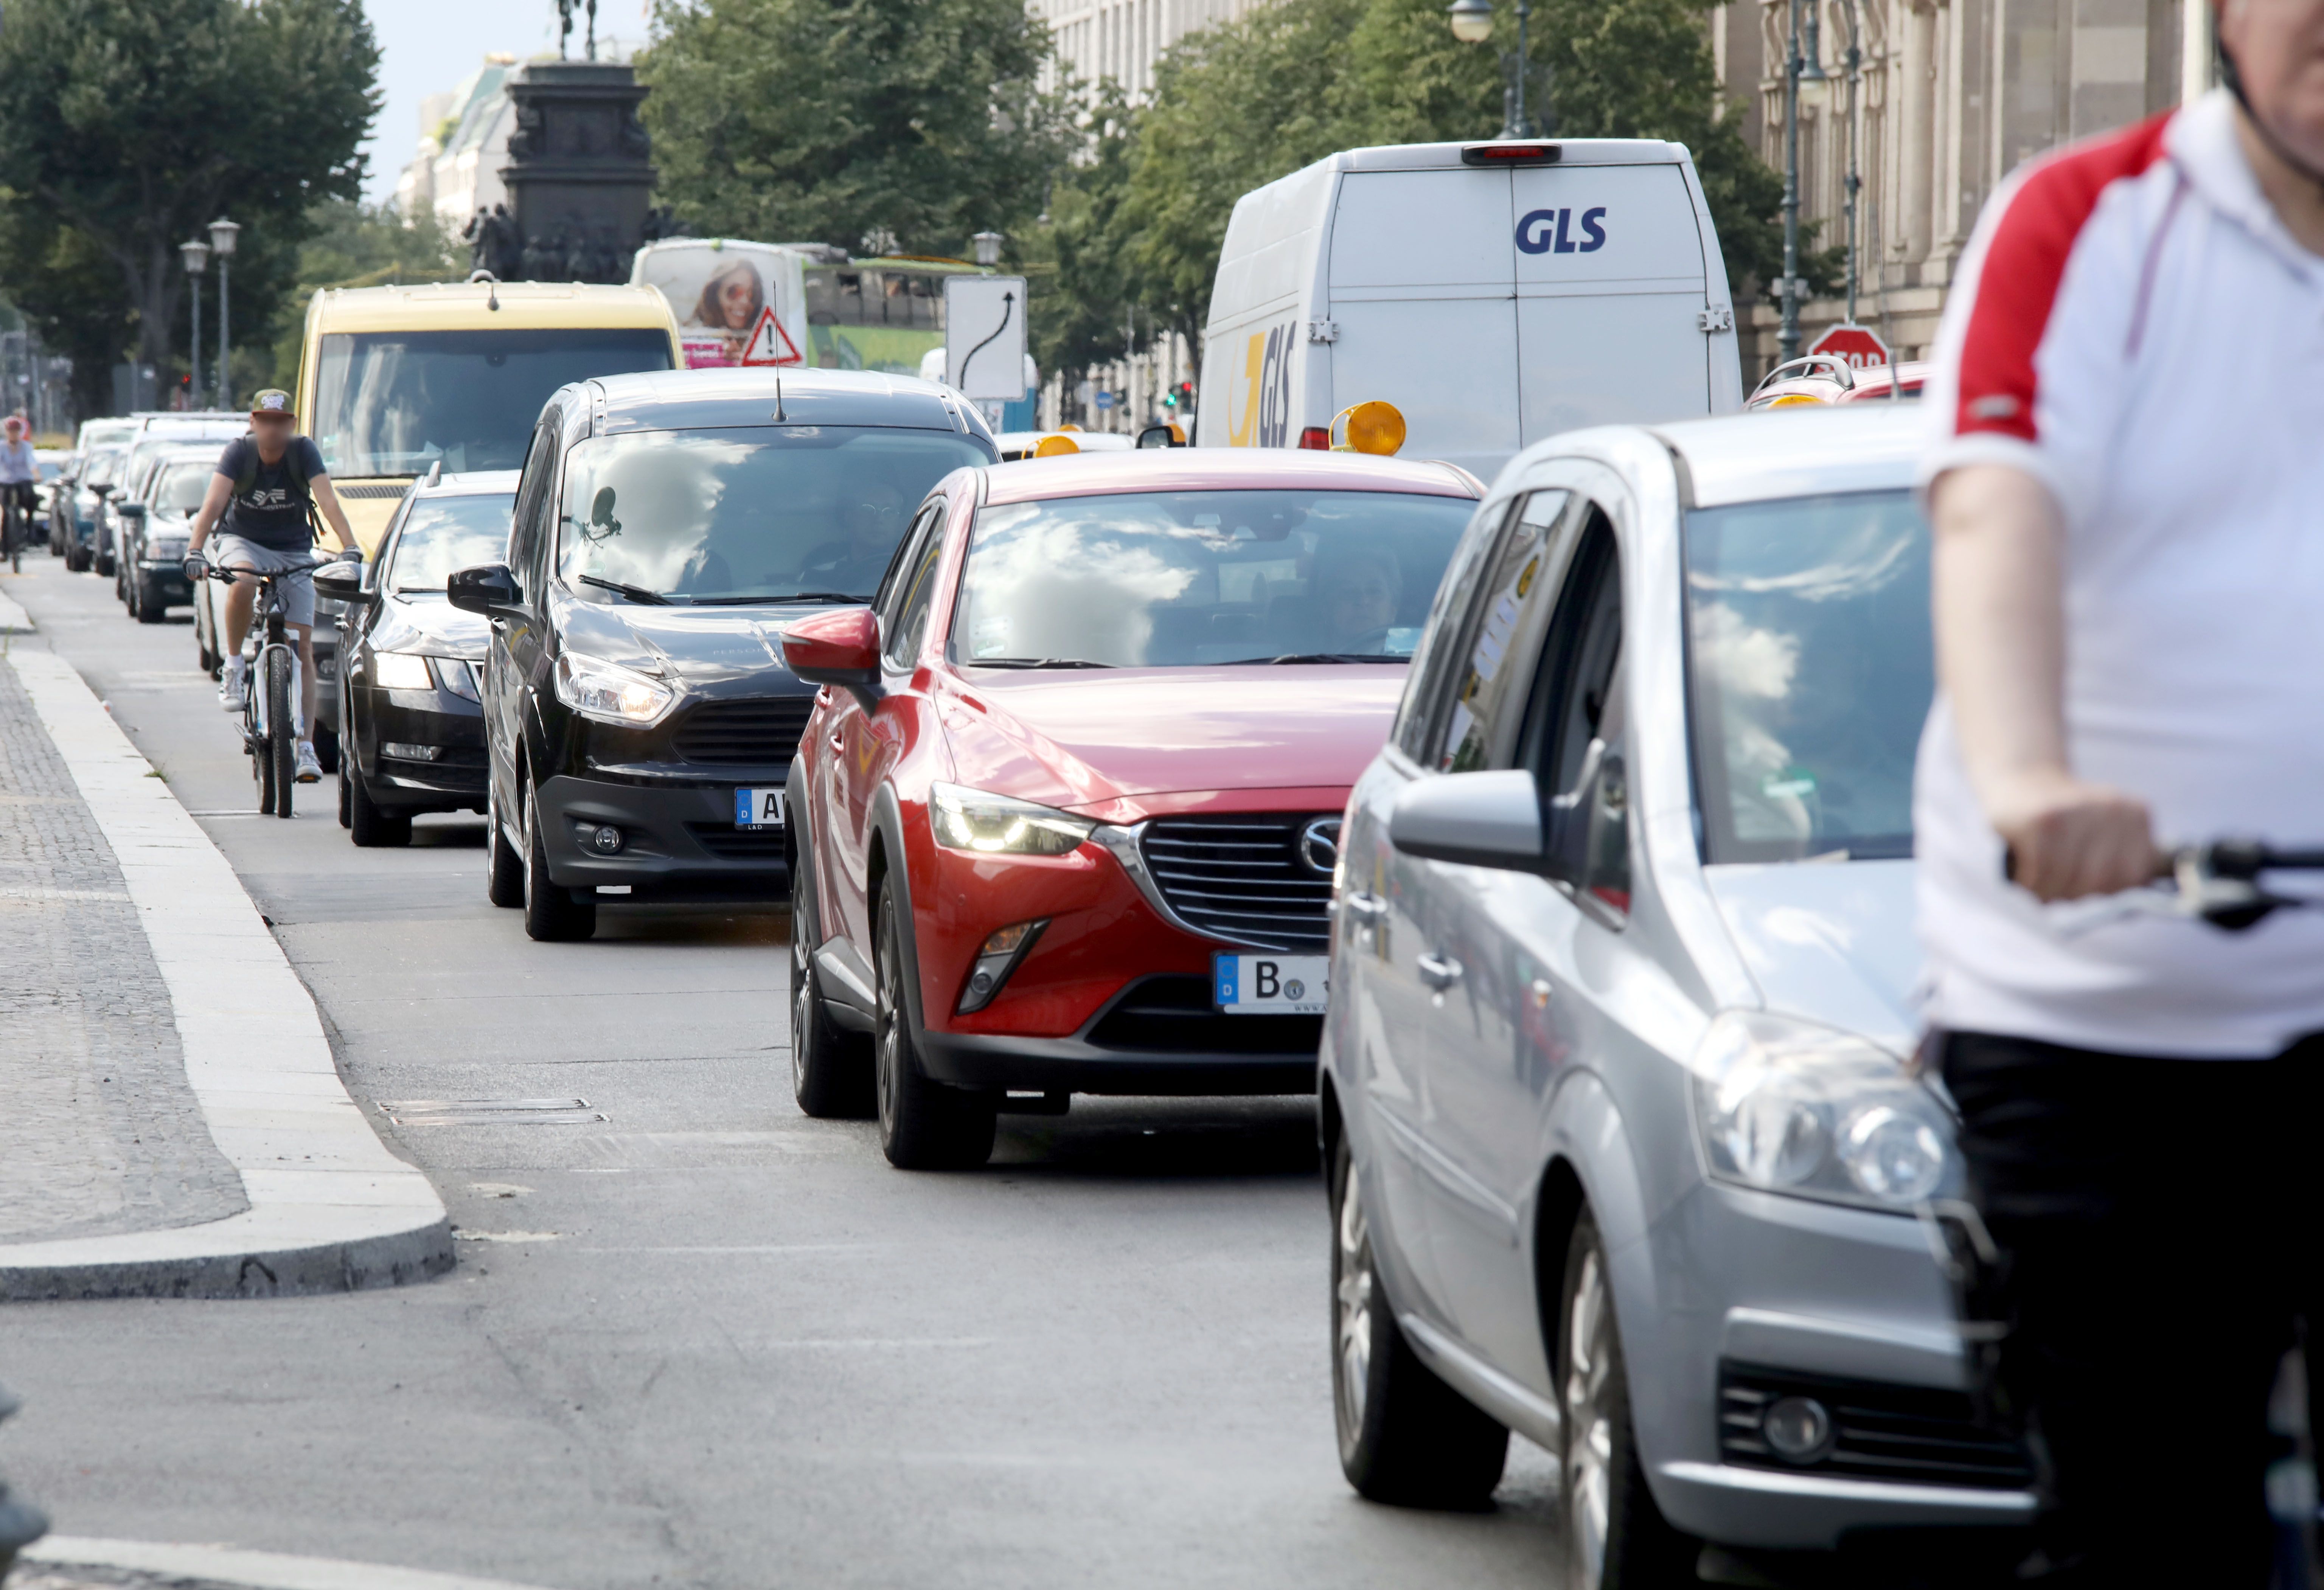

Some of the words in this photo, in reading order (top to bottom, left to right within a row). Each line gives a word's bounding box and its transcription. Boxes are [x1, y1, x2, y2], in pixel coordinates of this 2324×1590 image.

[1516, 207, 1606, 255] GLS
[1260, 320, 1296, 448] GLS
[1223, 984, 1232, 996] D
[1256, 961, 1280, 998] B
